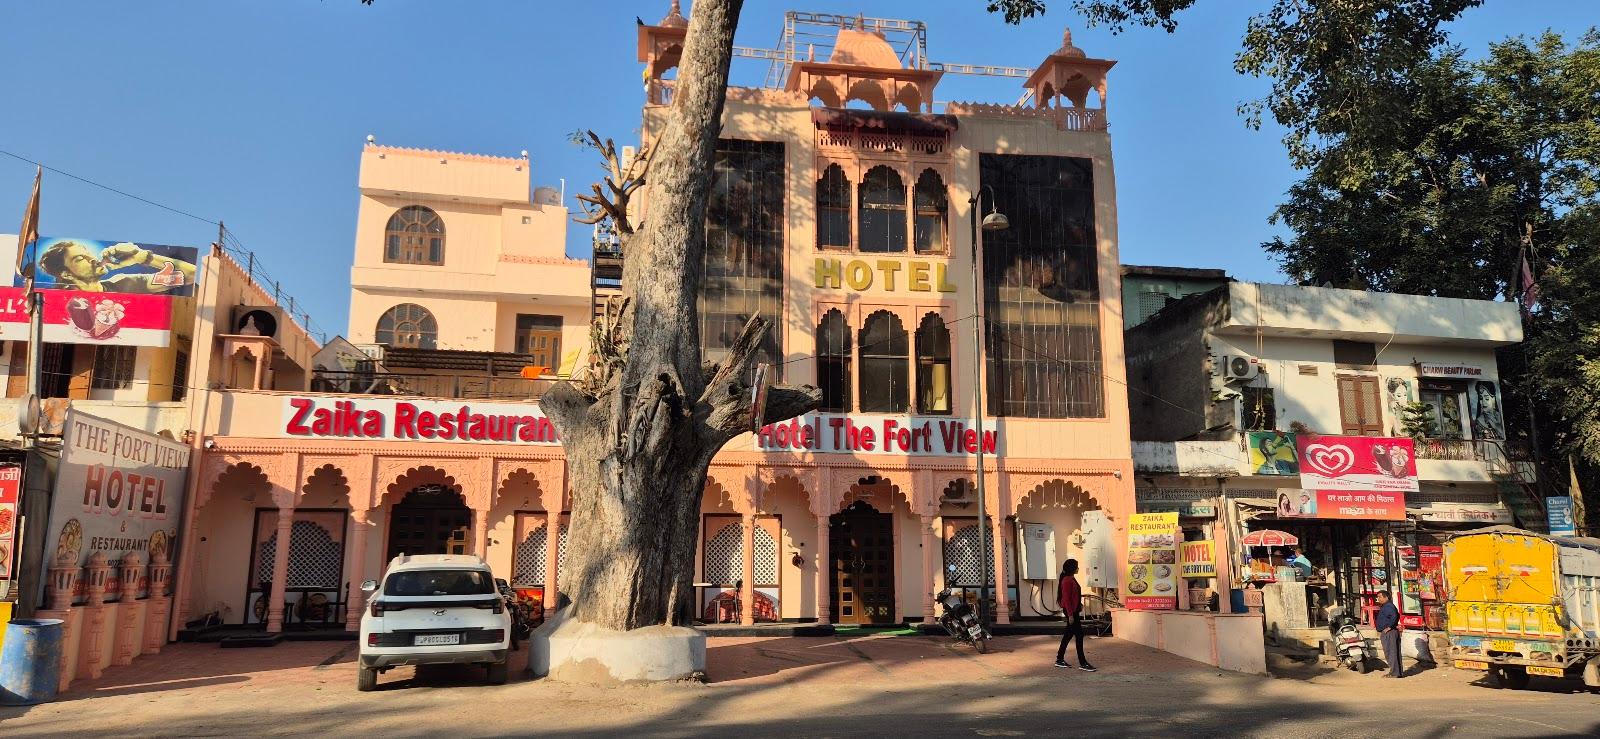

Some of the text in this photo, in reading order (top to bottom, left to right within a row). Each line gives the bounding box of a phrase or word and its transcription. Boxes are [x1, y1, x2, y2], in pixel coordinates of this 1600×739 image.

[814, 257, 956, 292] HOTEL
[1444, 366, 1463, 375] BEAUTY
[286, 398, 561, 442] Zaika Restauran
[758, 417, 997, 454] Hotel The Fort View
[75, 421, 187, 471] THE FORT VIEW
[83, 465, 167, 515] HOTEL
[90, 536, 149, 552] RESTAURANT
[1130, 523, 1176, 531] RESTAURANT
[1183, 543, 1211, 563] HOTEL
